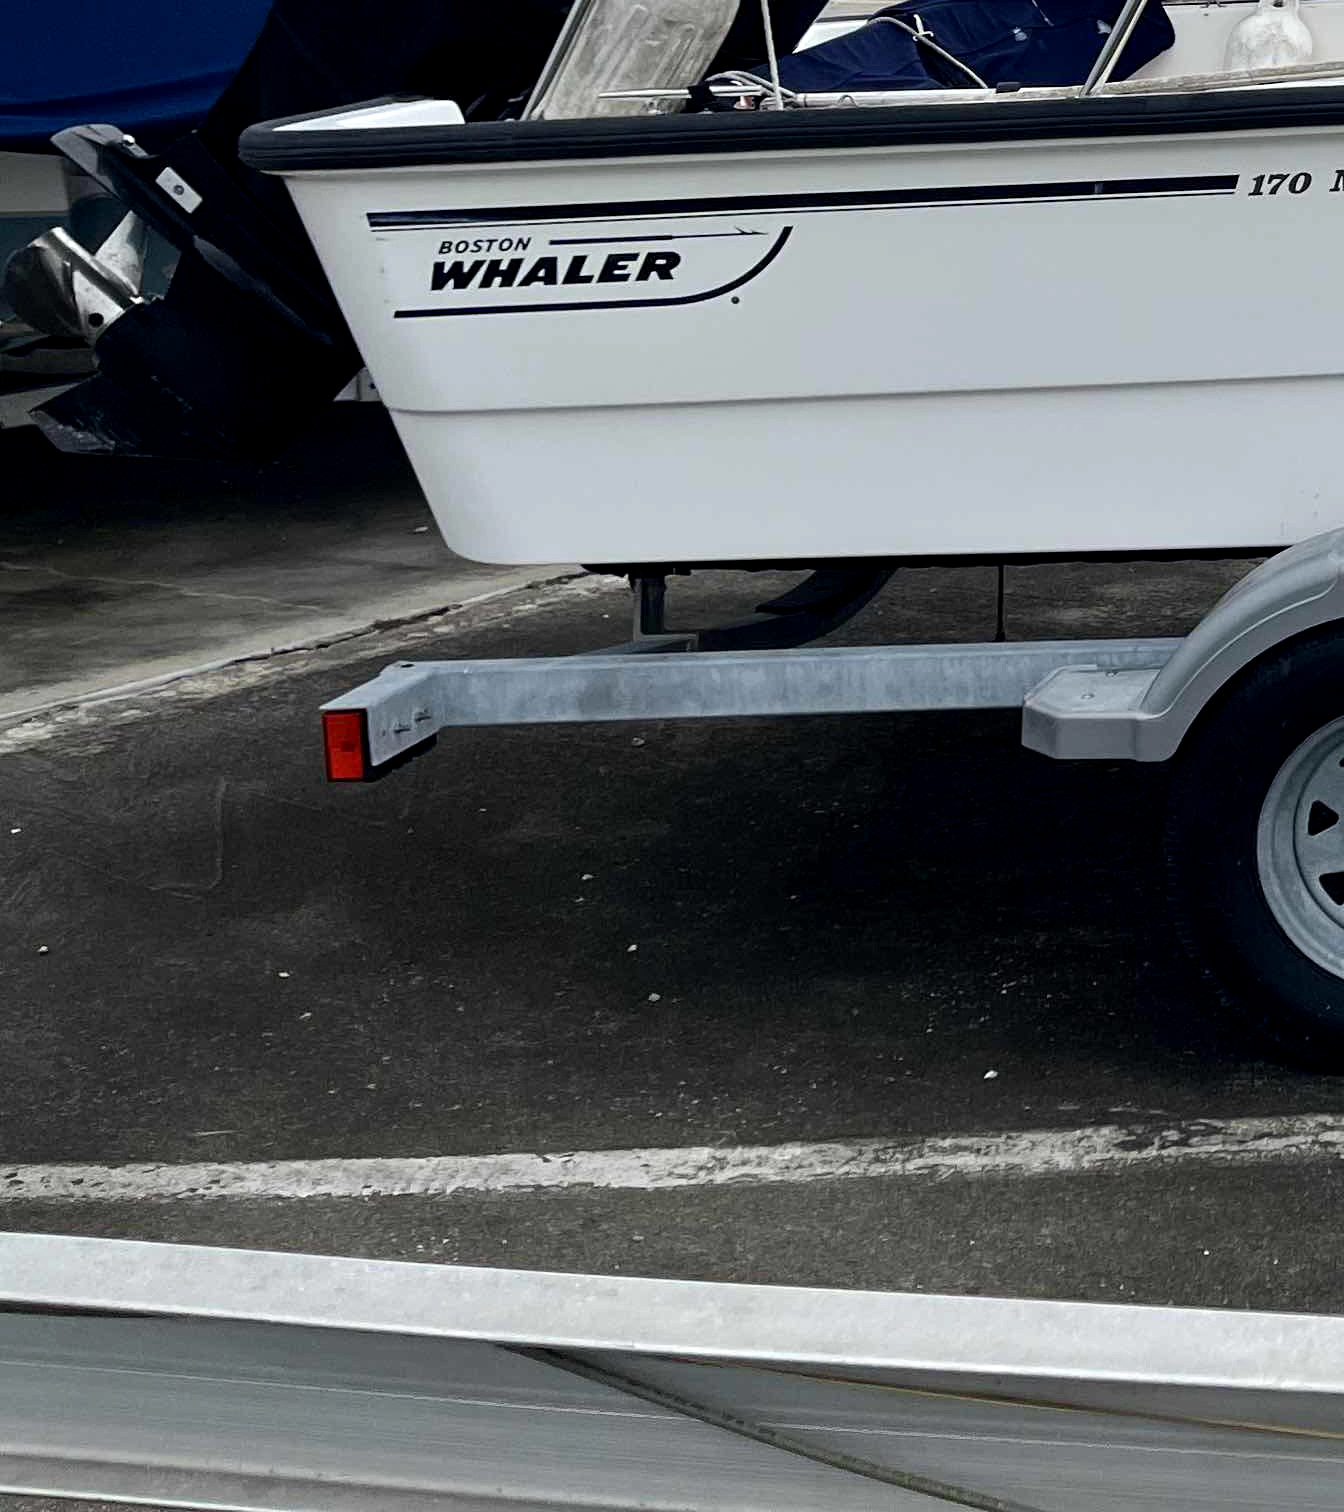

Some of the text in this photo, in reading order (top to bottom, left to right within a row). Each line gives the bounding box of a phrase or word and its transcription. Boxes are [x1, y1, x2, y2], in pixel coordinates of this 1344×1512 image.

[1247, 171, 1313, 197] 170
[438, 236, 532, 255] BOSTON
[430, 251, 682, 292] WHALER
